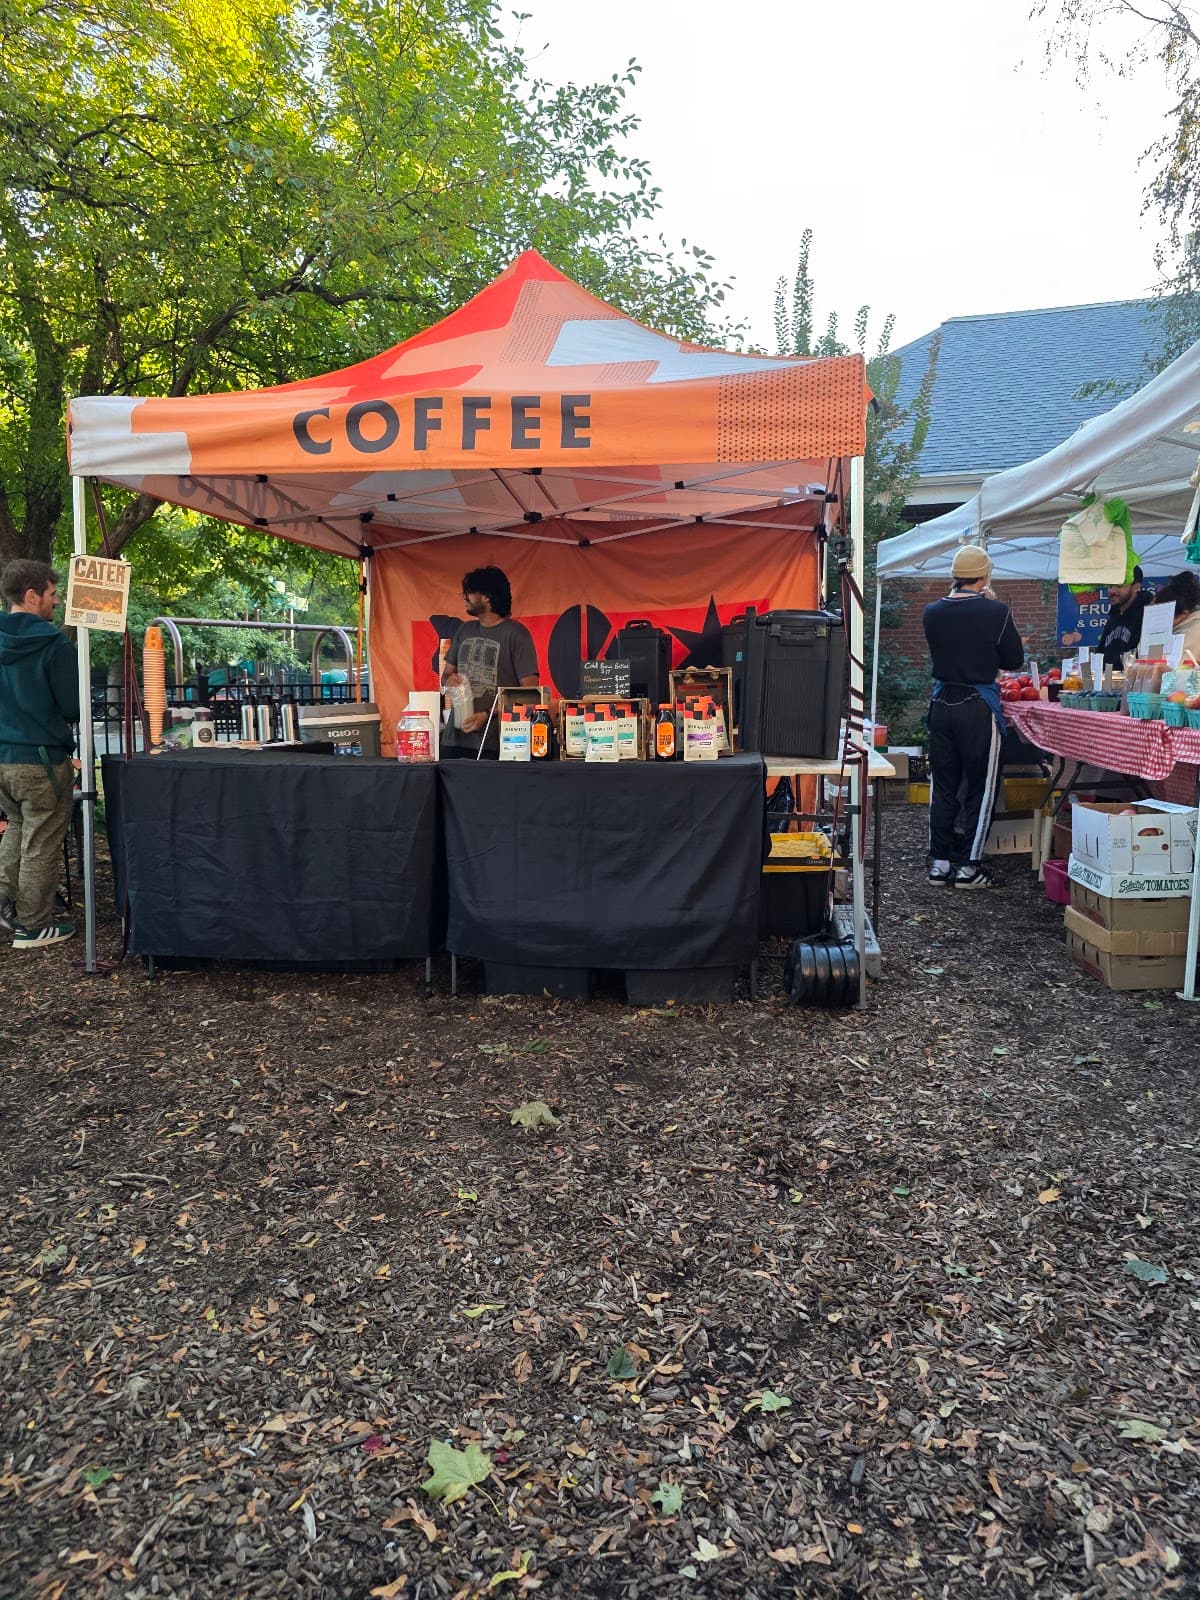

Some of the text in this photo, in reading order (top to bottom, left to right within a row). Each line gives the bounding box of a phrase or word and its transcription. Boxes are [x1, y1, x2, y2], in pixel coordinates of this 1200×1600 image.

[293, 395, 591, 454] COFFEE
[75, 557, 126, 584] CATER
[1079, 604, 1112, 615] FRU
[1077, 620, 1085, 628] &
[328, 729, 360, 738] IGLOO
[1144, 879, 1190, 891] TOMATOES
